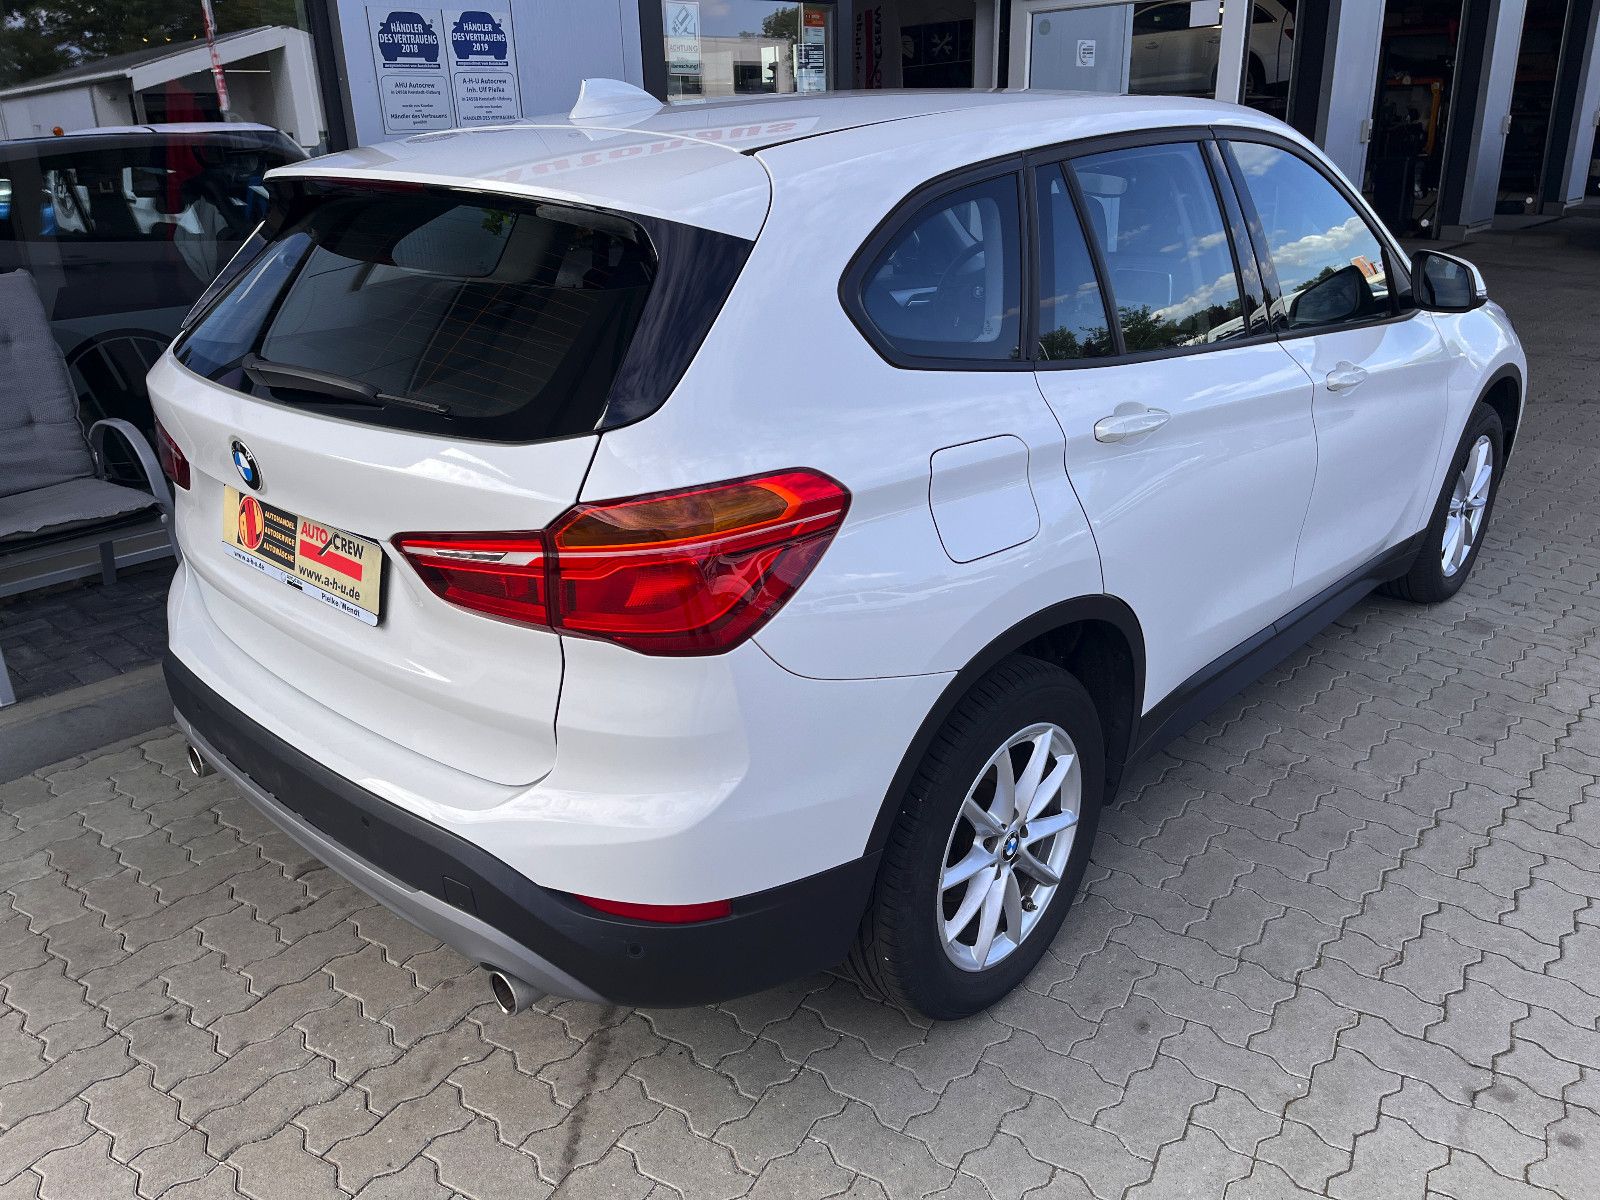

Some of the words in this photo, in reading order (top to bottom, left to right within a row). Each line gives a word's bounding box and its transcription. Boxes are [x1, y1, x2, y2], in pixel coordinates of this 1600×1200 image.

[390, 20, 424, 33] HÄNDLER
[463, 21, 493, 32] HÄNDLER
[379, 33, 393, 43] DES
[393, 34, 438, 45] VERTRAUENS
[452, 32, 465, 41] DES
[465, 33, 506, 42] VERTRAUENS
[401, 44, 419, 53] 2018
[472, 43, 489, 51] 2019
[264, 510, 296, 530] AUTOHANDEL
[301, 521, 329, 545] AUTO
[333, 533, 364, 560] CREW
[298, 565, 361, 601] www.a-h-u.de
